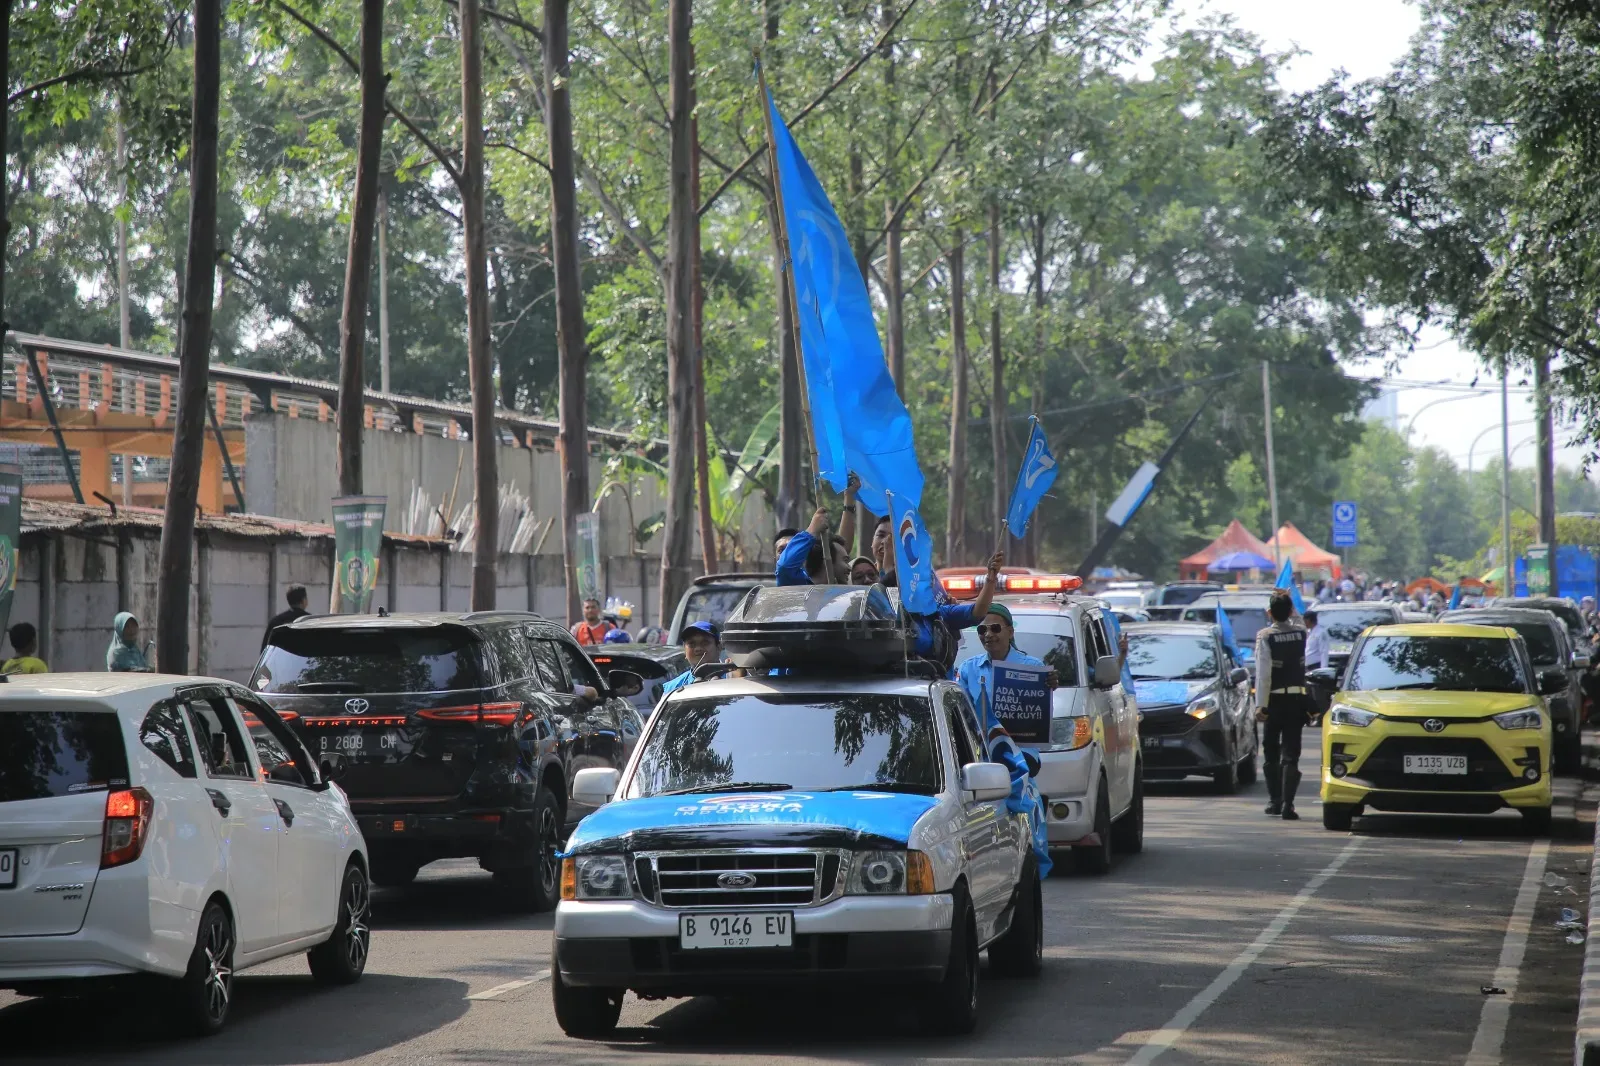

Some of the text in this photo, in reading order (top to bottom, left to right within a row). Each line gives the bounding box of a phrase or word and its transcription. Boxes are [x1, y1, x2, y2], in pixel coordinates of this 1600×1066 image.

[995, 686, 1045, 698] ADA YANG
[994, 702, 1042, 712] MASA IYA
[994, 710, 1042, 720] GAK KUY!!
[320, 736, 328, 750] B
[335, 736, 363, 749] 2609
[1405, 756, 1466, 769] B 1135 VZB
[673, 807, 801, 816] INDONESIA
[727, 876, 746, 885] Ford
[686, 916, 787, 937] B 9146 EV
